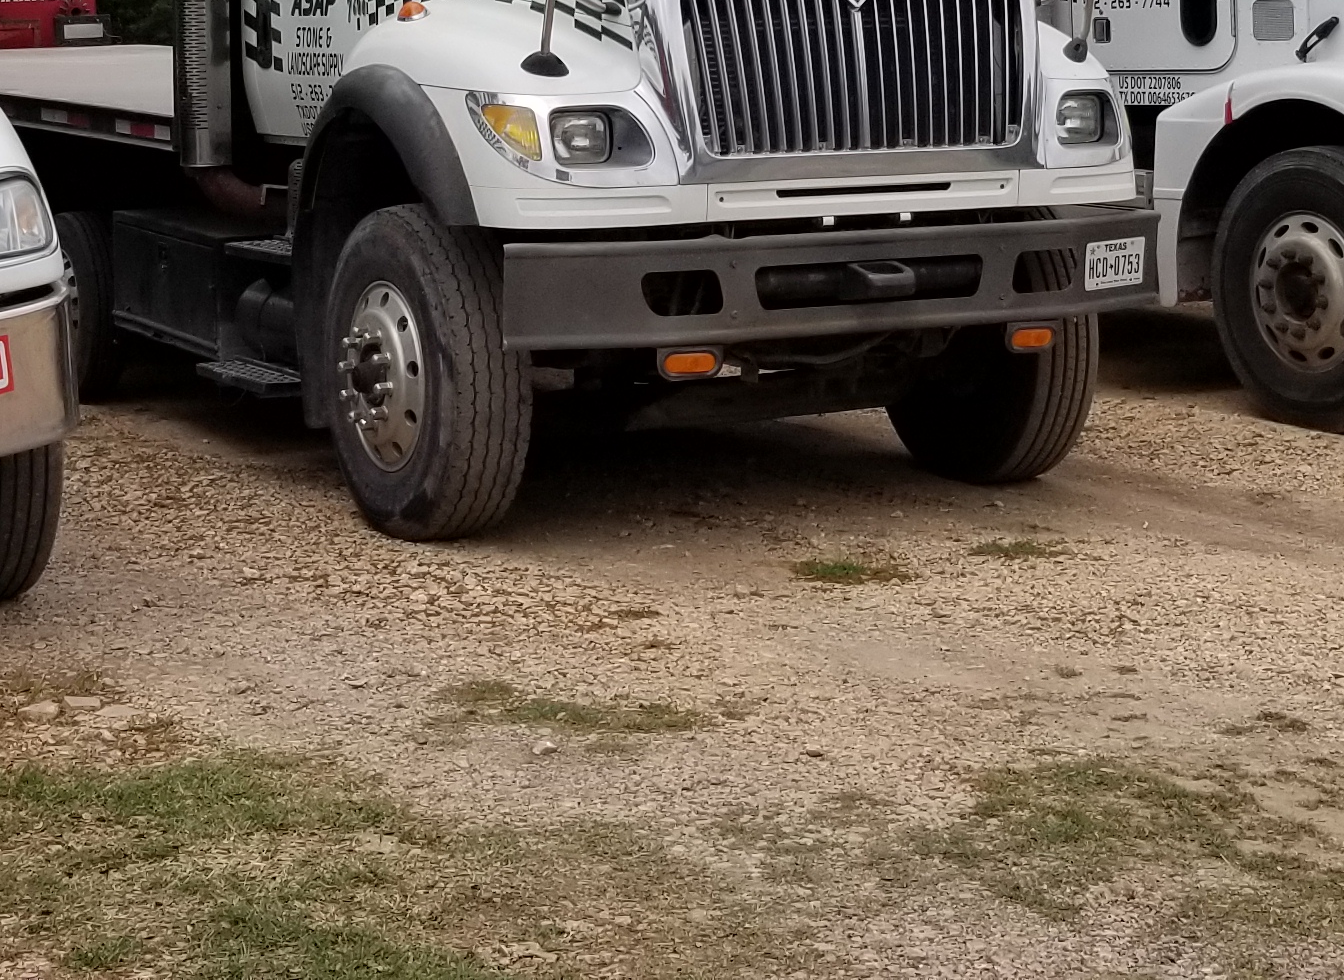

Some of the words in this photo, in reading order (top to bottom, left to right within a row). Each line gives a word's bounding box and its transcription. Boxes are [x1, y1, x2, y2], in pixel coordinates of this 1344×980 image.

[296, 26, 323, 49] STONE
[326, 26, 332, 49] &
[287, 51, 321, 76] LANDSCAPE
[321, 53, 344, 77] SUPPLY
[1119, 76, 1129, 89] US
[1130, 76, 1146, 89] DOT
[1148, 76, 1181, 90] 2207806
[1130, 91, 1146, 105] DOT
[1104, 242, 1128, 253] TEXAS
